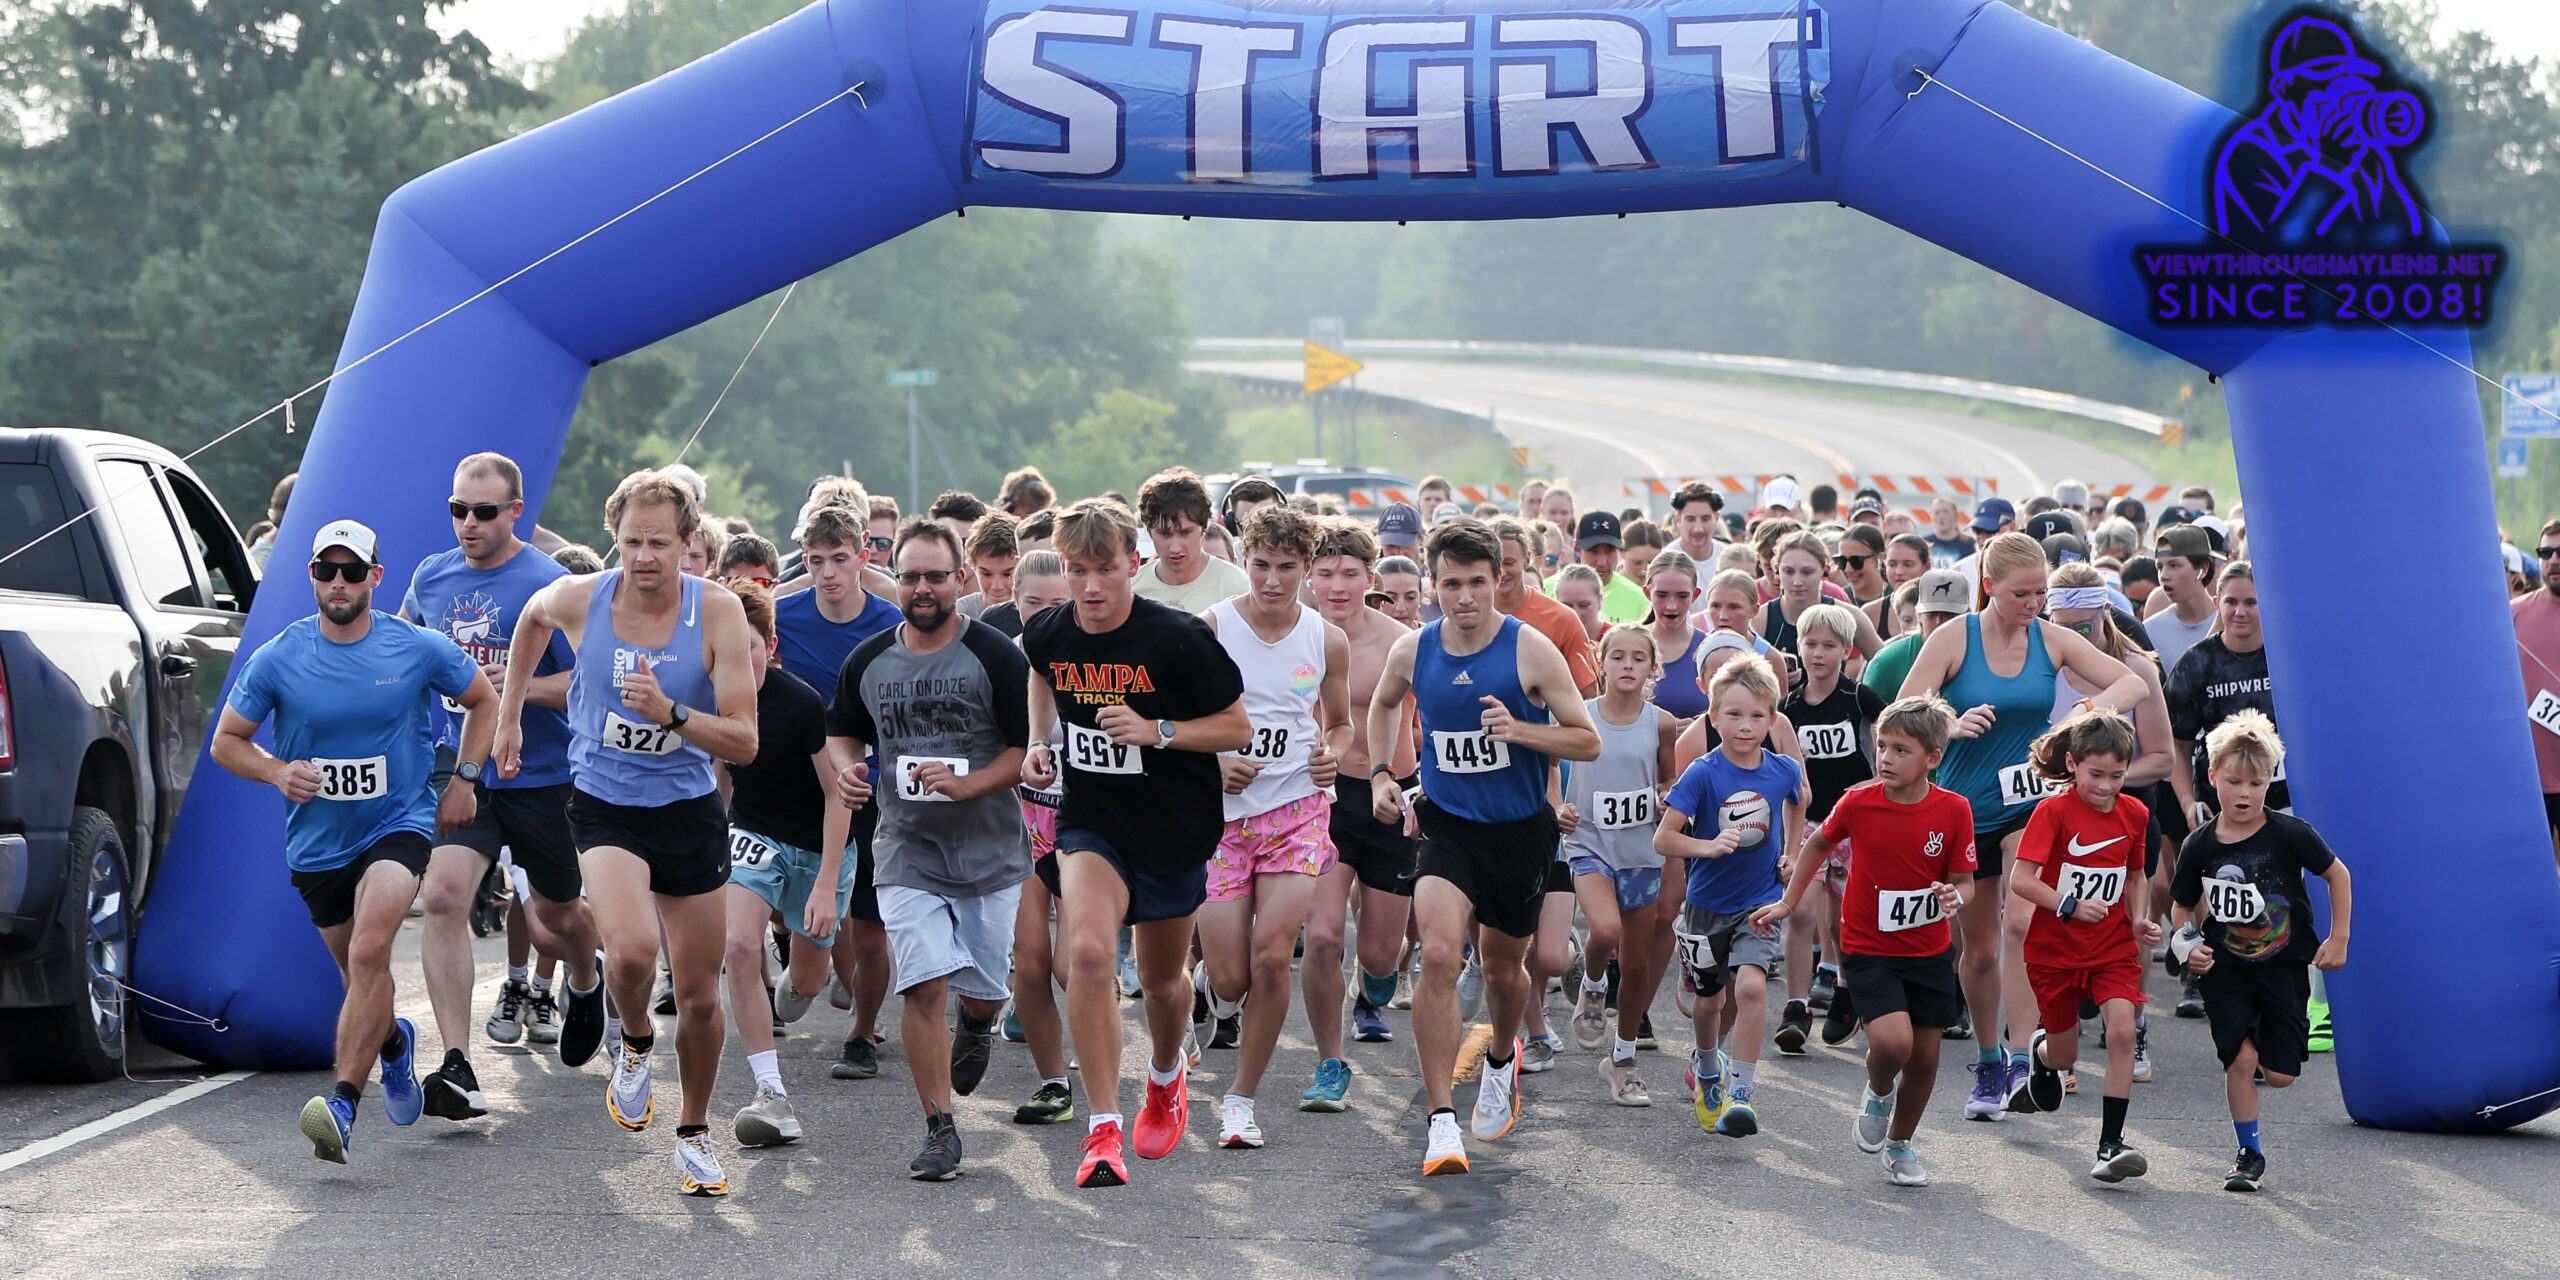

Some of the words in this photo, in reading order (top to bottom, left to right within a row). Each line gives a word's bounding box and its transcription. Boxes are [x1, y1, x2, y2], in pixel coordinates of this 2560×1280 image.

[975, 6, 1822, 180] START
[2045, 521, 2055, 536] P
[612, 648, 626, 687] ESKO
[1049, 661, 1156, 693] TAMPA
[878, 680, 932, 700] CARLTON
[934, 678, 967, 696] DAZE
[1073, 692, 1127, 705] TRACK
[2206, 677, 2271, 699] SHIPWRE
[880, 701, 912, 740] 5K
[914, 721, 934, 737] RUN
[615, 724, 667, 753] 327
[1445, 737, 1498, 768] 449
[1806, 727, 1846, 756] 302
[322, 763, 377, 796] 385
[2012, 769, 2057, 799] 40
[1603, 794, 1648, 826] 316
[2071, 871, 2118, 903] 320
[2209, 884, 2255, 920] 466
[1890, 892, 1940, 926] 470
